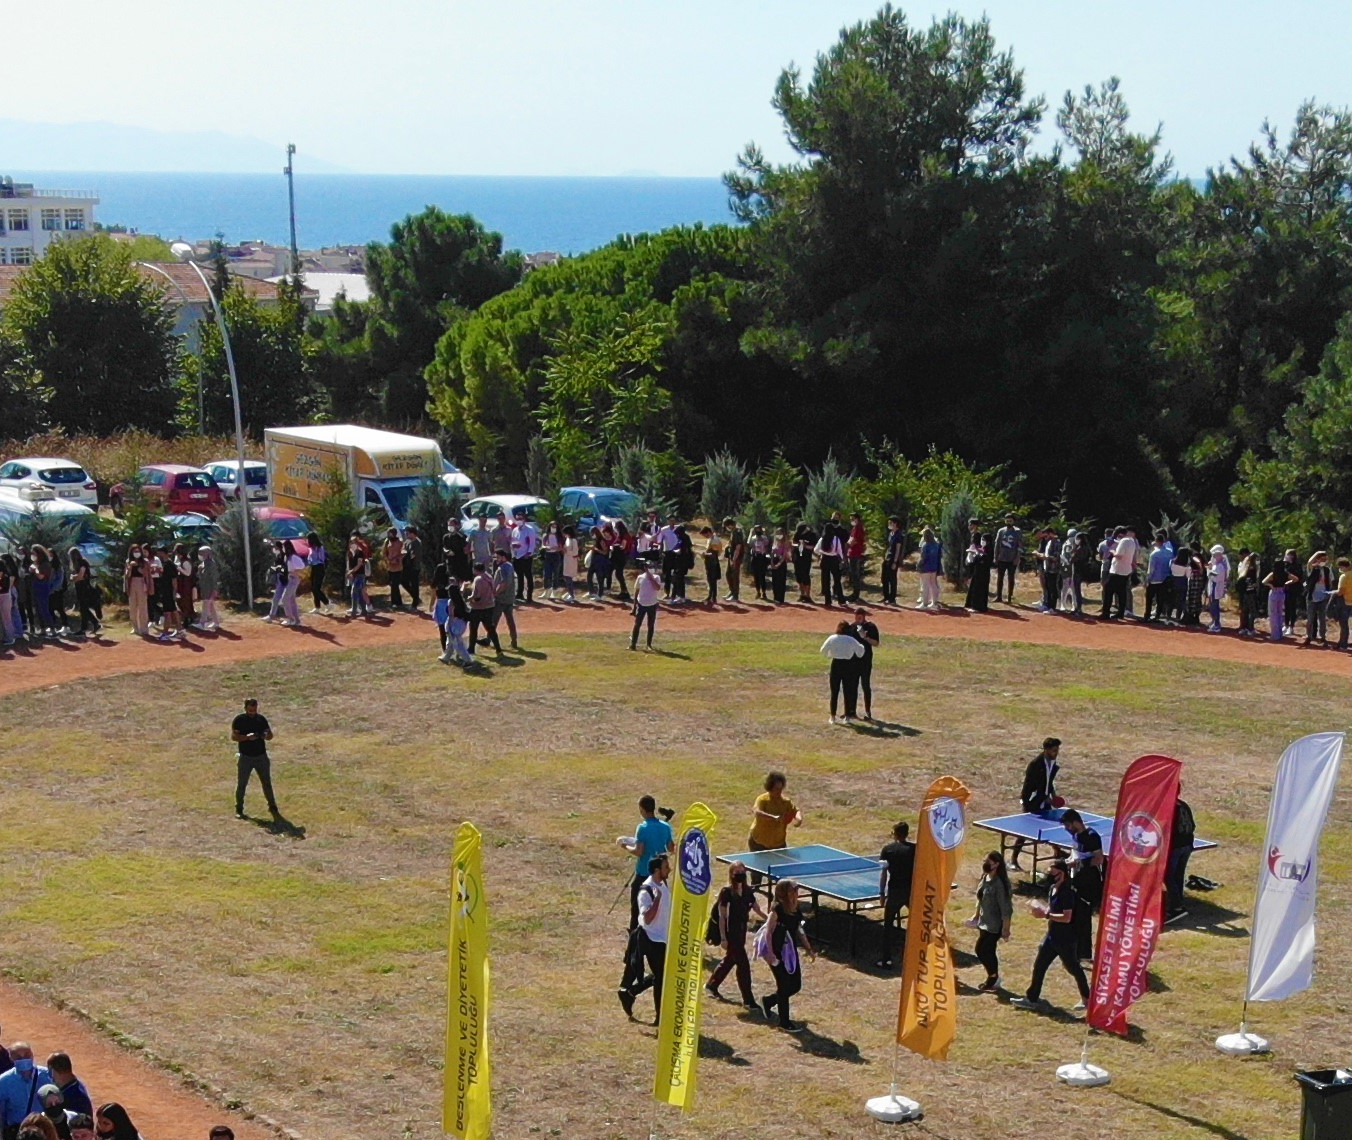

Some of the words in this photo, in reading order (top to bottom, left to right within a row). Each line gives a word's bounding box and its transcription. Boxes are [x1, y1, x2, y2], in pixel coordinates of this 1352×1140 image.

[919, 880, 937, 945] SANAT
[1105, 894, 1123, 944] BİLİMİ
[1117, 882, 1141, 957] YÖNETİMİ
[458, 938, 468, 1017] DİYETETİK
[677, 959, 687, 973] VE
[1096, 947, 1115, 1005] SİYASET
[1113, 960, 1131, 1007] KAMU
[459, 1020, 468, 1041] VE
[674, 976, 686, 1038] EKONOMİSİ
[468, 995, 478, 1085] TOPLULUĞU
[456, 1046, 467, 1131] BESLENME
